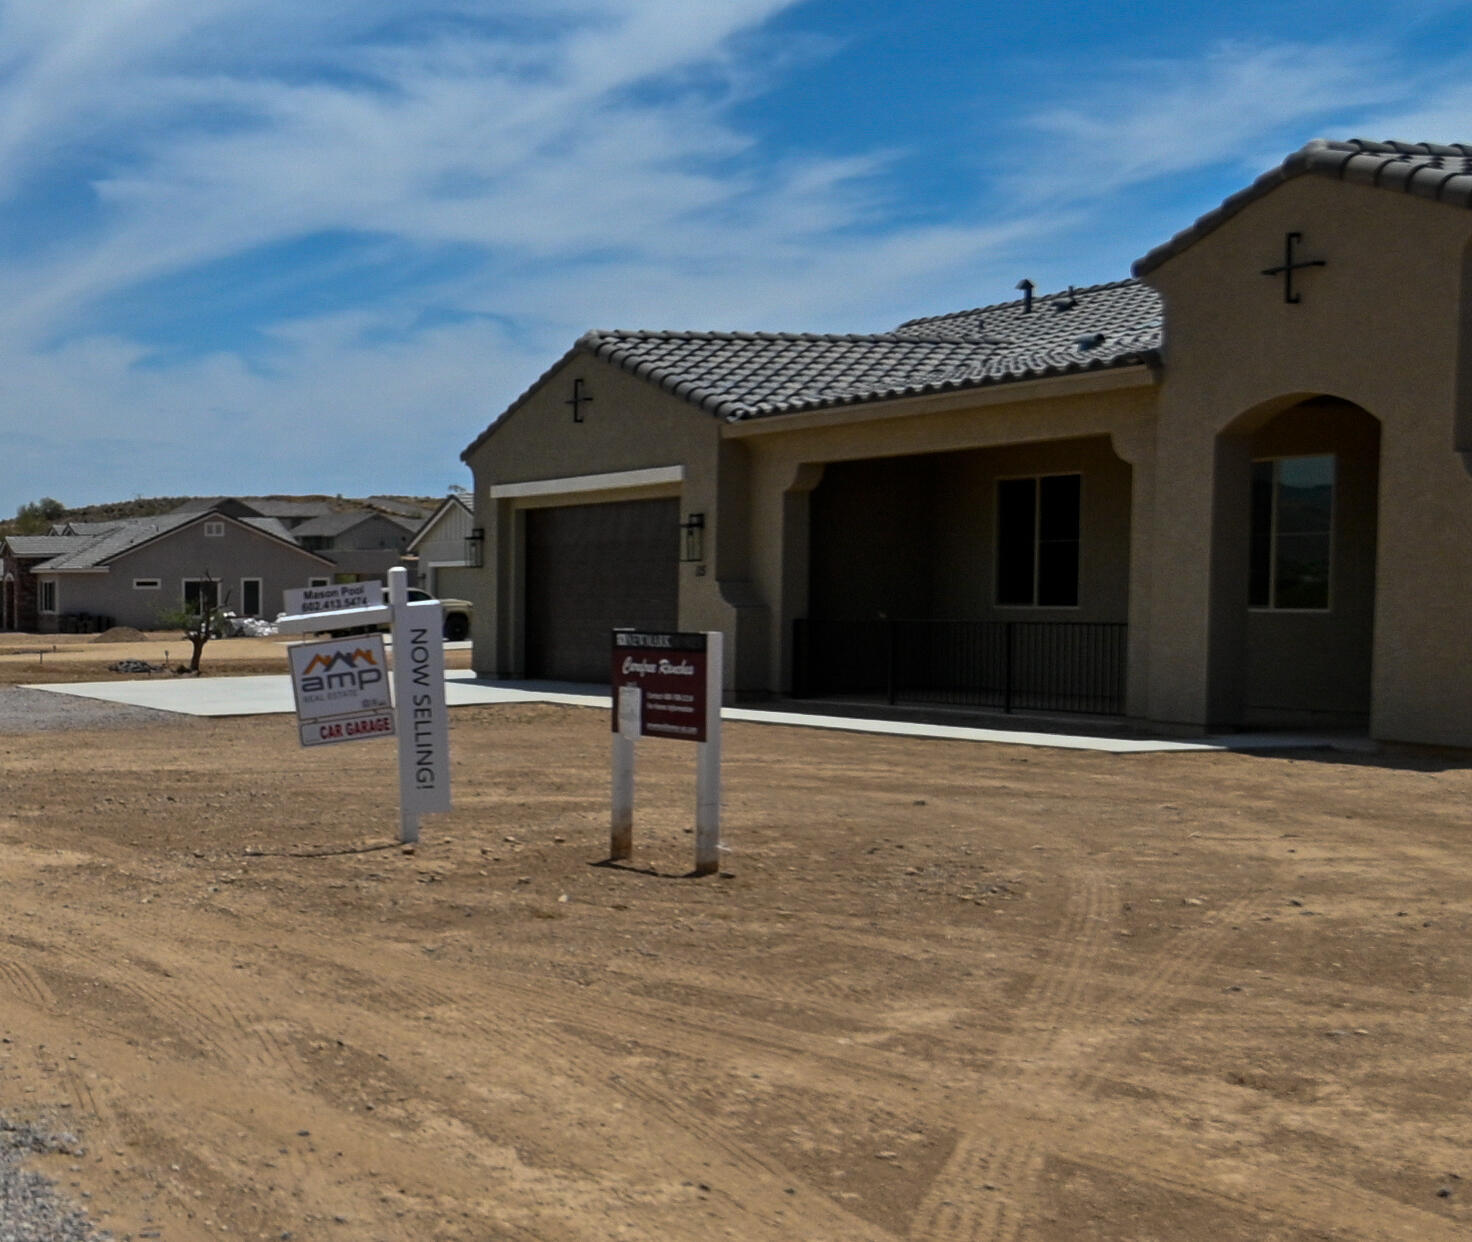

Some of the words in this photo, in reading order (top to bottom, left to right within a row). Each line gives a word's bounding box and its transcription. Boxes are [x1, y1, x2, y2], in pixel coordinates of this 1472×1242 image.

[303, 589, 338, 600] Mason
[341, 586, 365, 597] Pool
[410, 628, 430, 686] NOW
[301, 668, 382, 692] amp
[328, 690, 357, 700] ESTATE
[320, 724, 343, 739] CAR
[345, 717, 392, 736] GARAGE
[413, 695, 435, 790] SELLING!
